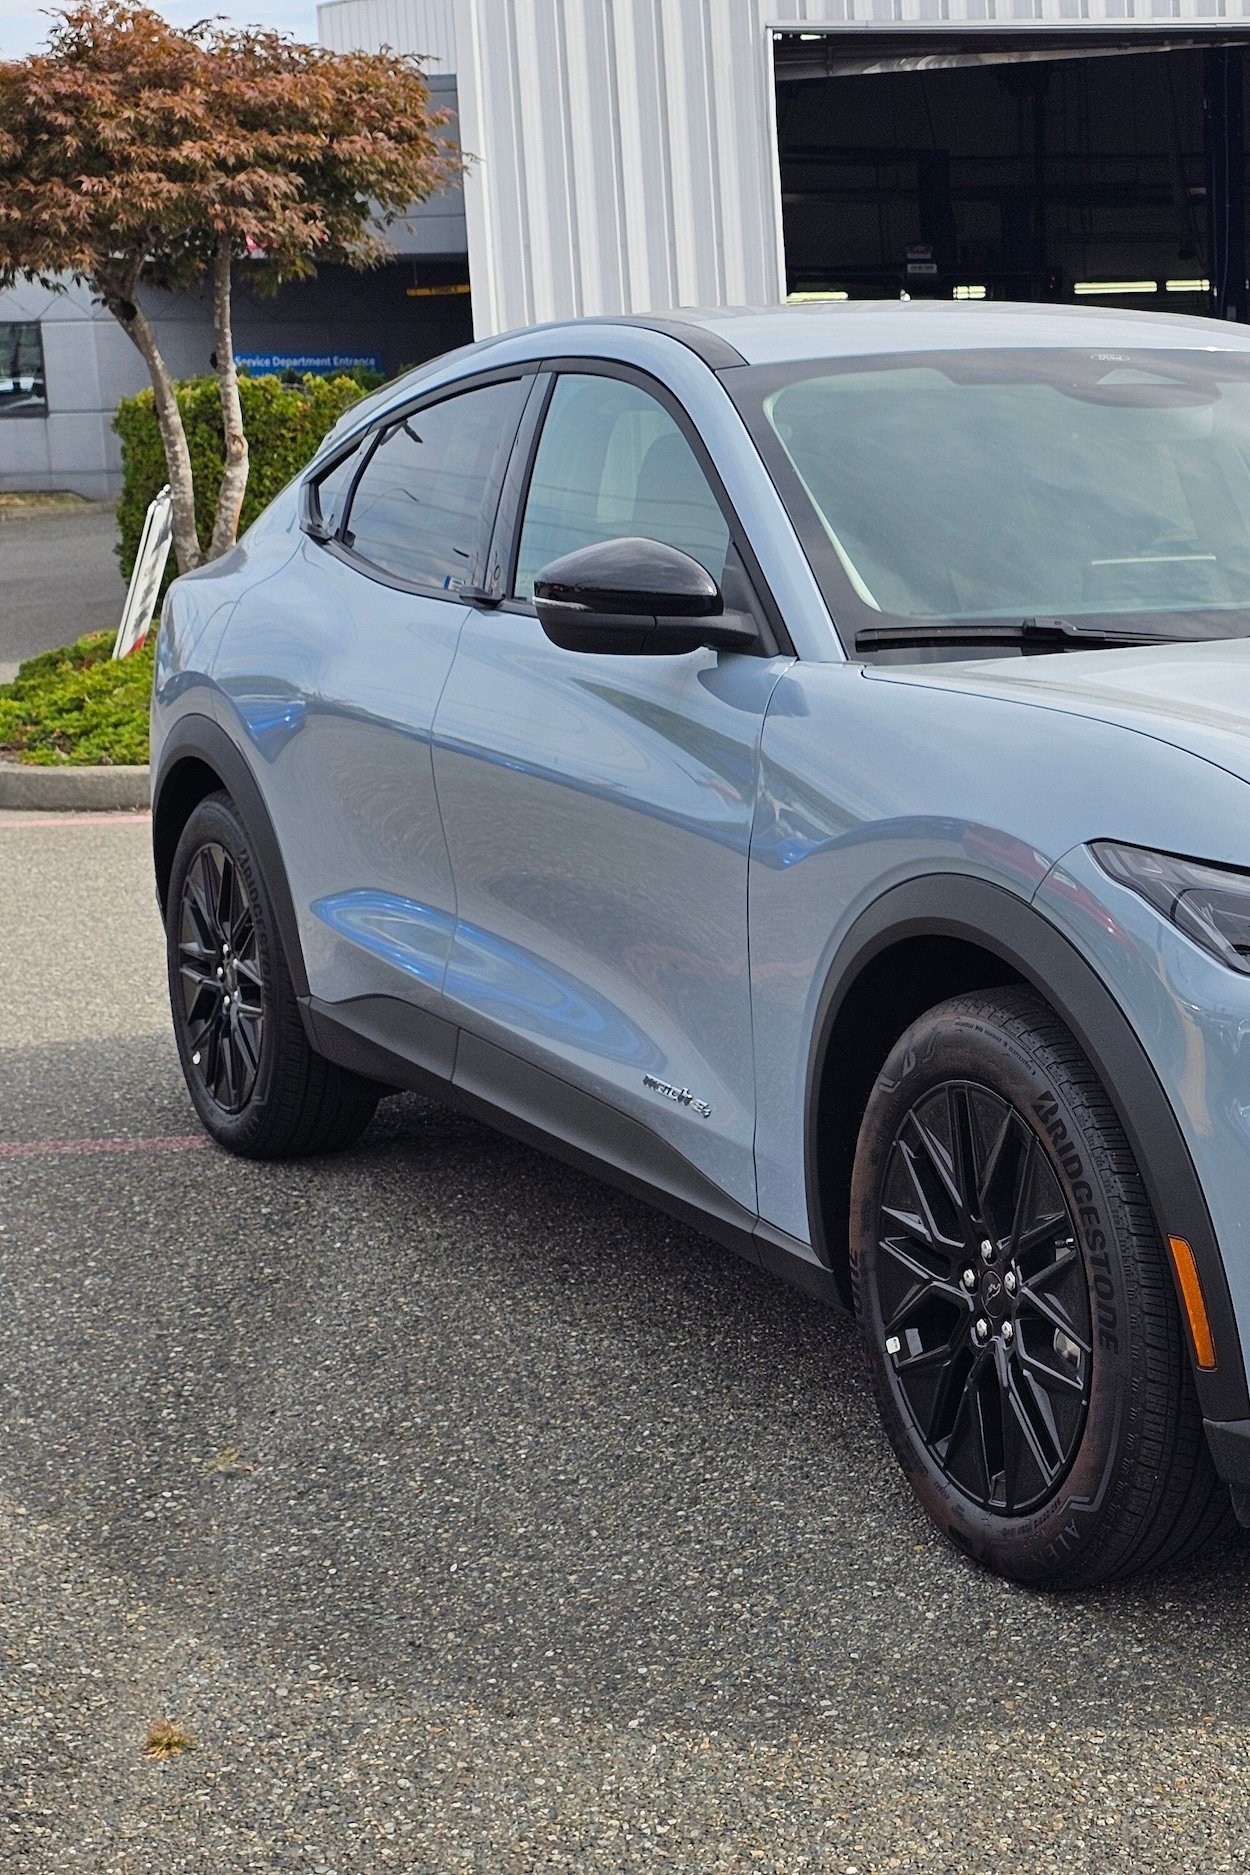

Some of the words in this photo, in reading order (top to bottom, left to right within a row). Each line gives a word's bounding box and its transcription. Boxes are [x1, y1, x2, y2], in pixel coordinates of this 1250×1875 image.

[234, 355, 270, 367] Service
[272, 356, 331, 368] Department
[333, 356, 376, 366] Entrance
[1032, 1091, 1119, 1356] BRIDGESTONE
